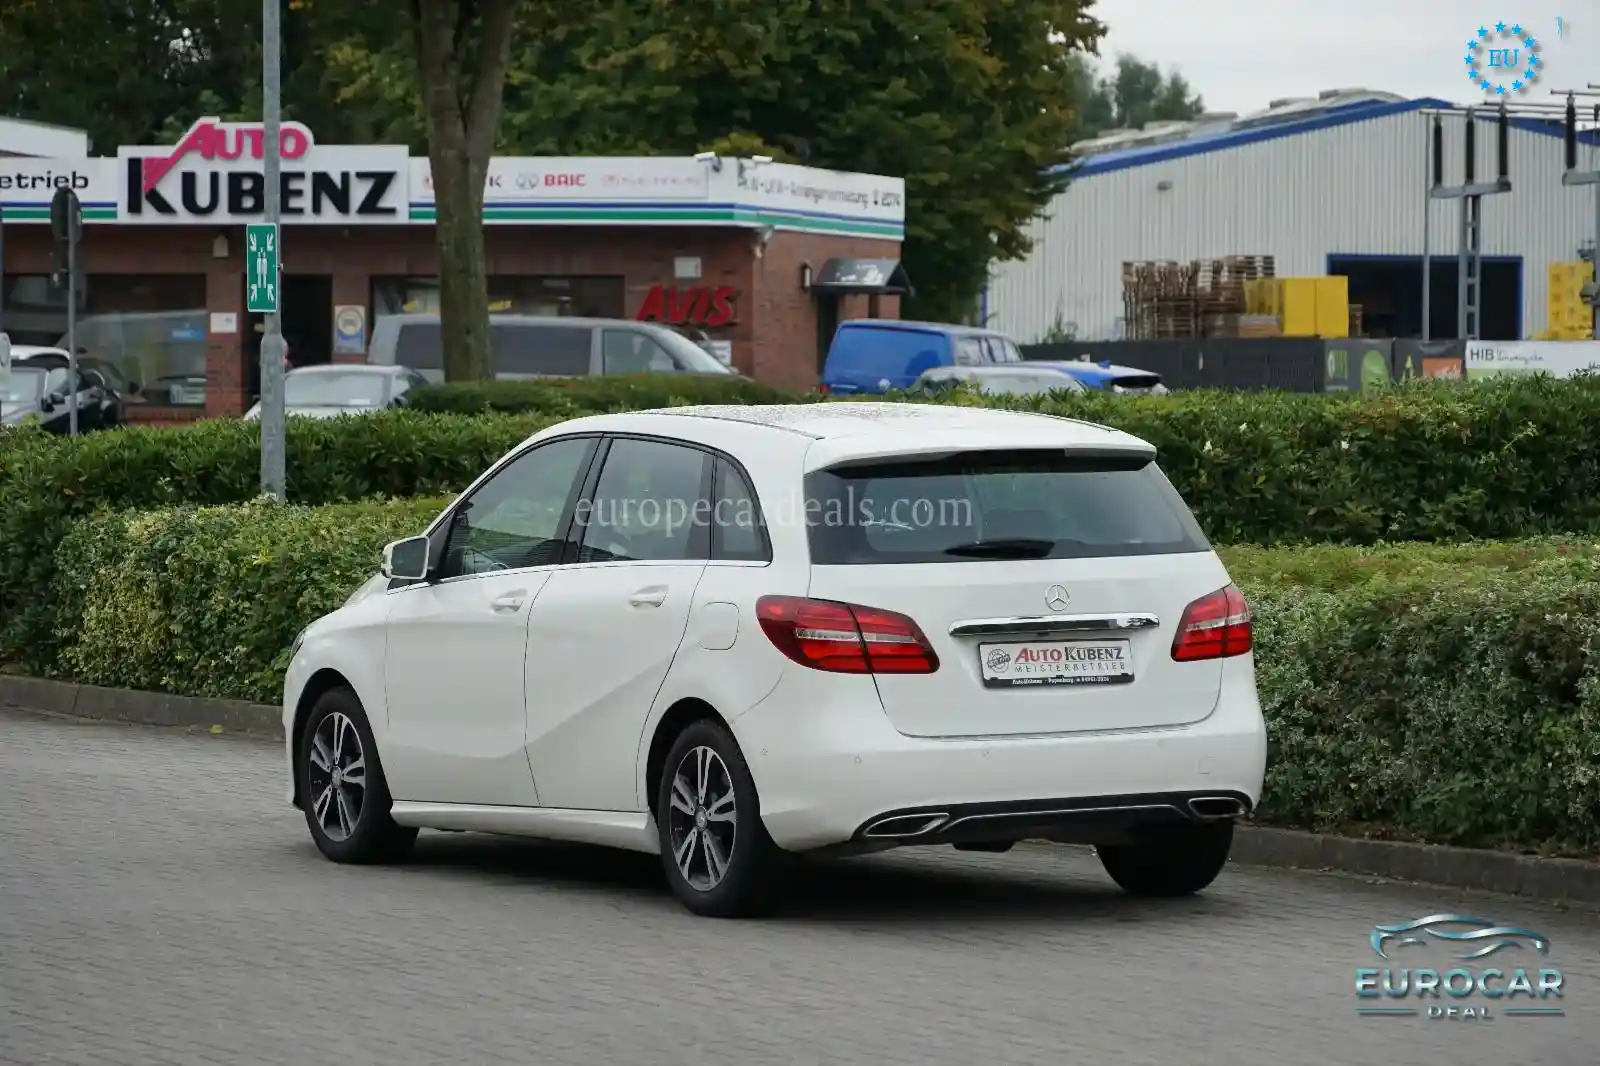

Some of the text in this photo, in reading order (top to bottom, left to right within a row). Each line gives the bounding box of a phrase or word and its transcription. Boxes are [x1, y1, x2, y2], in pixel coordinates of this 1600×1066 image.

[178, 122, 309, 161] AUTO
[127, 157, 398, 215] KUBENZ
[544, 174, 586, 187] BAIC
[636, 285, 737, 327] AVIS
[1470, 348, 1495, 361] HIB
[1014, 647, 1062, 663] AUTO
[1064, 646, 1124, 661] KUBENZ
[1014, 663, 1125, 673] MEISTERBETRIEB
